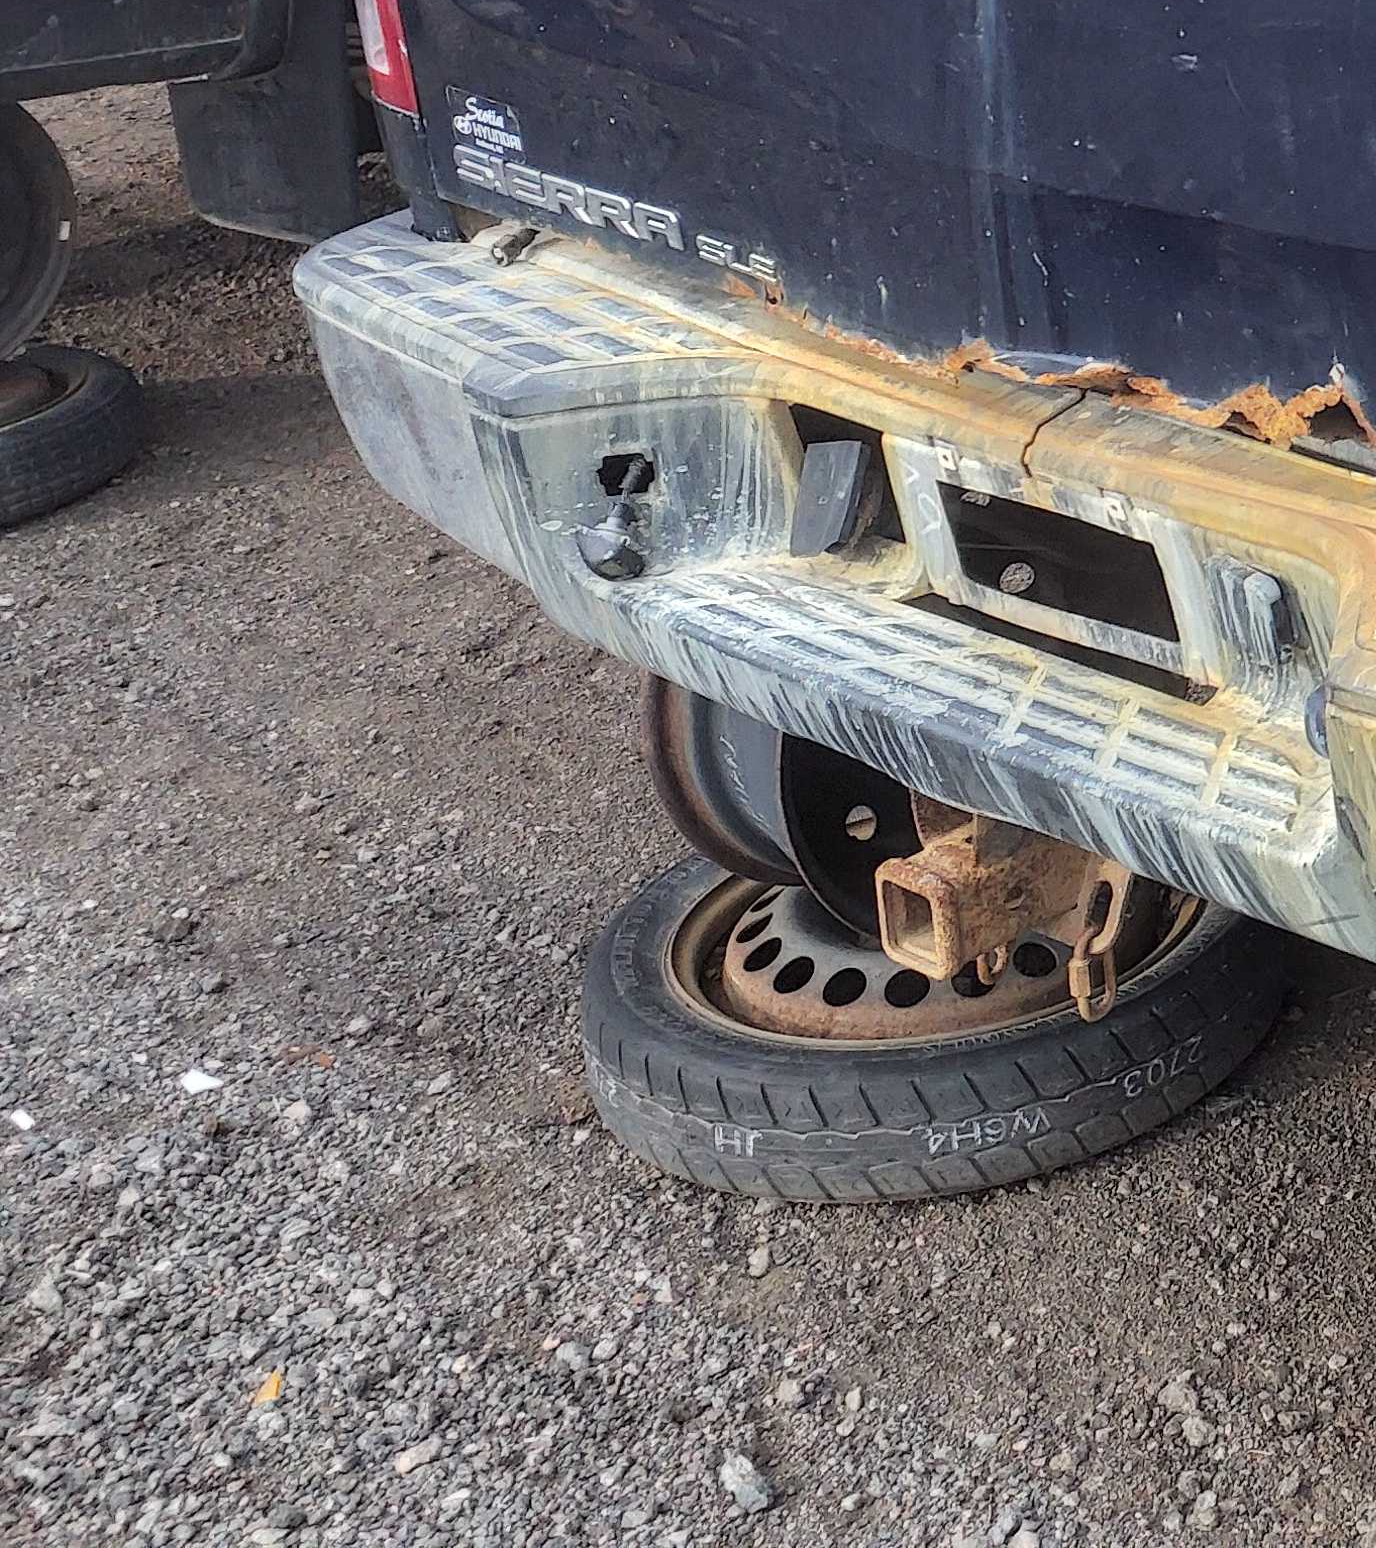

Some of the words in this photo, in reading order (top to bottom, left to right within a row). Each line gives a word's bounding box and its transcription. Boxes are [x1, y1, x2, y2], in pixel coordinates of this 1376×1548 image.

[472, 121, 522, 151] HYUNDAI
[453, 144, 684, 251] SIERRA
[697, 235, 777, 282] SLE
